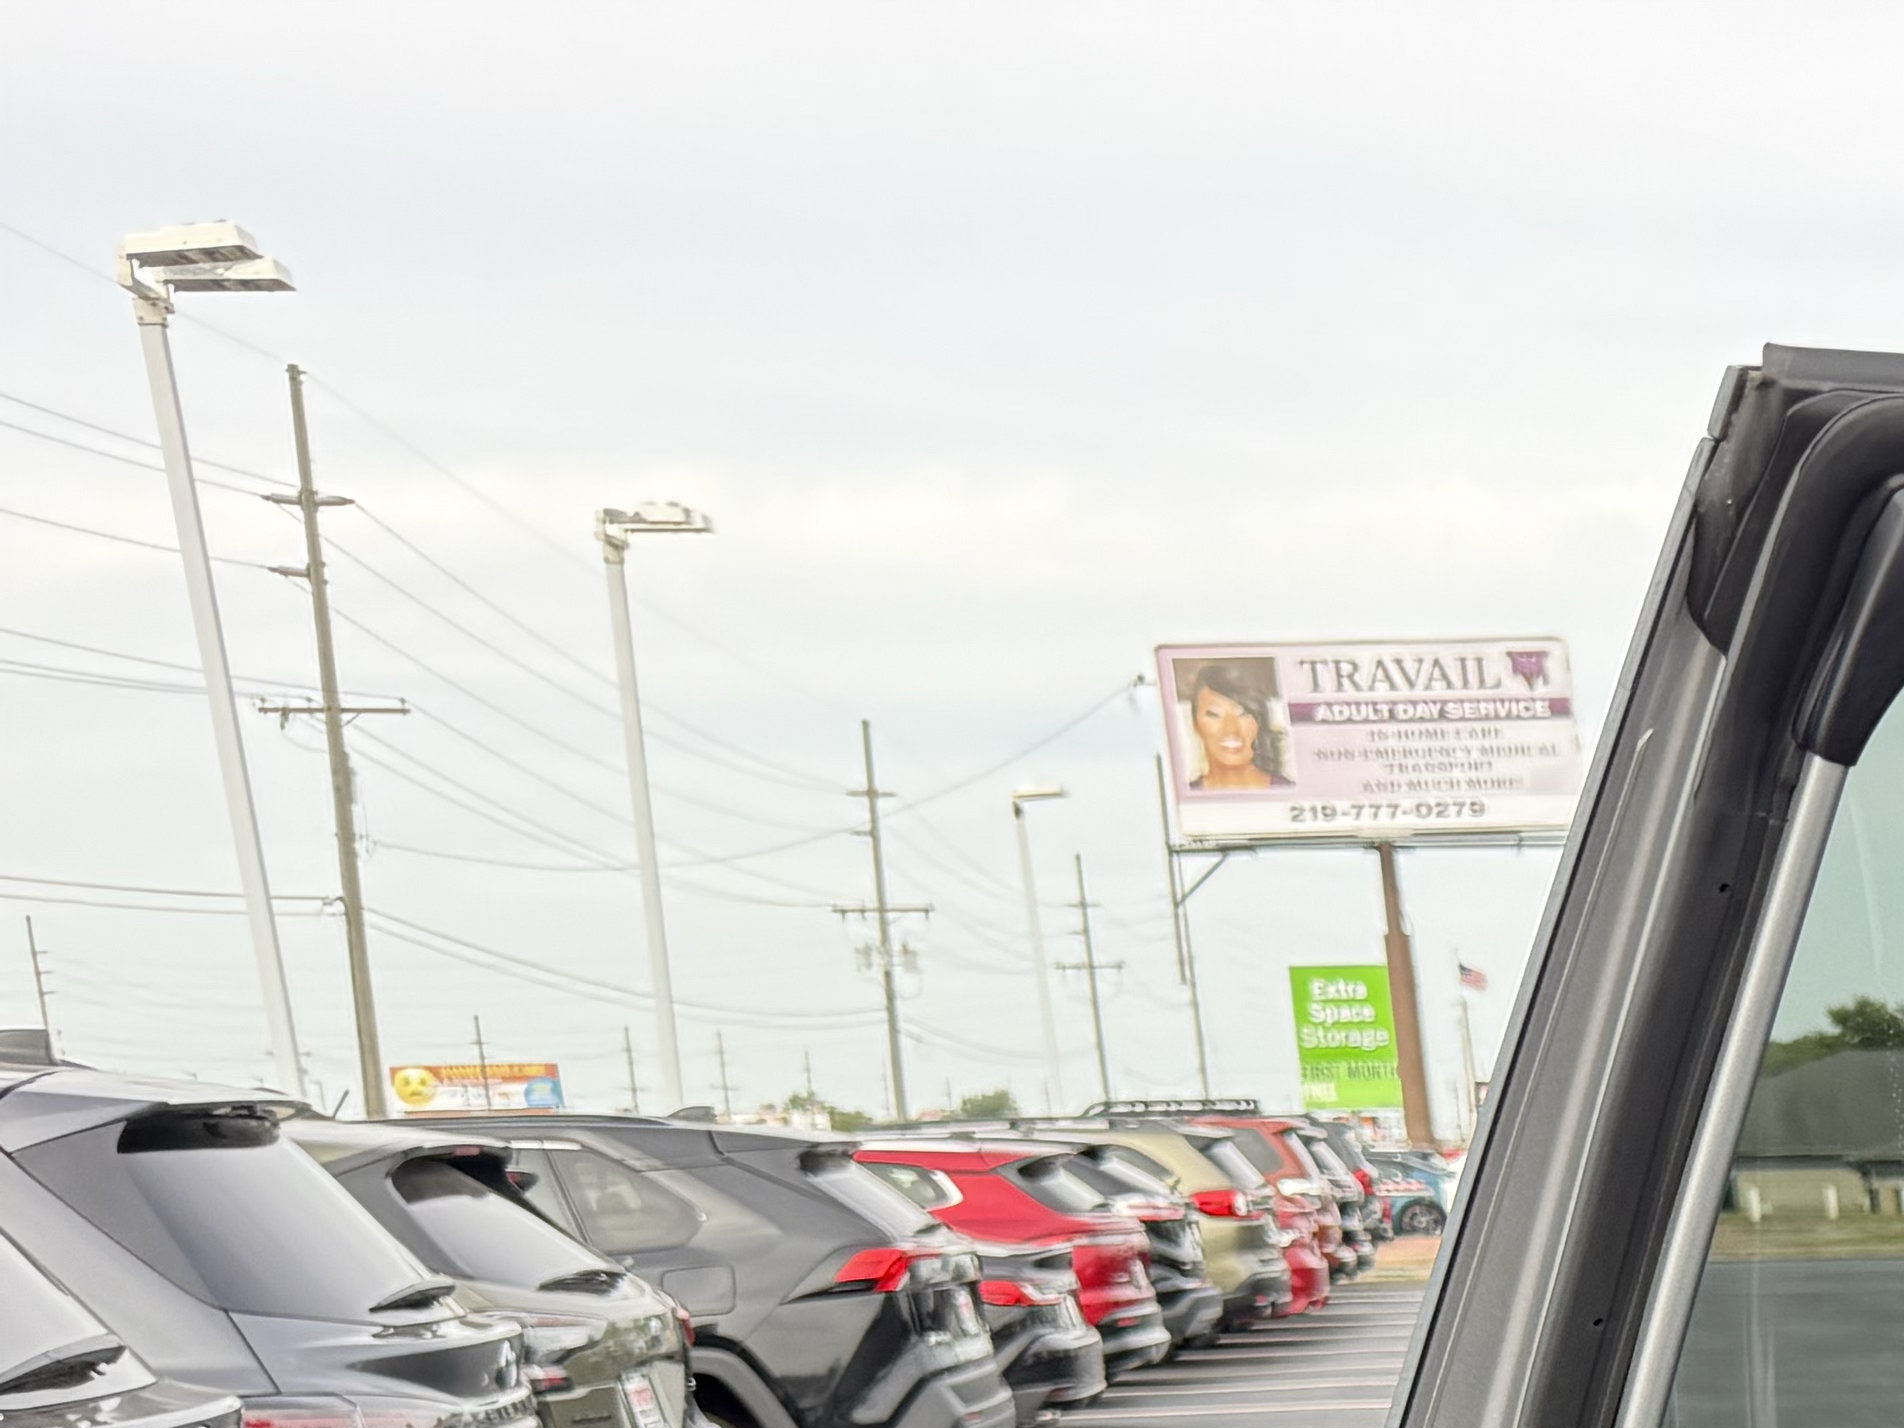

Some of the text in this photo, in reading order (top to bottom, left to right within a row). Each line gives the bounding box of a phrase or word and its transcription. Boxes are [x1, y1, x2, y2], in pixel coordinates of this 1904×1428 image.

[1300, 656, 1502, 693] TRAVAIL
[1314, 699, 1551, 722] ADULT DAY SERVICE
[1290, 800, 1486, 824] 219-777-0279
[1310, 978, 1368, 999] Extra
[1309, 1002, 1376, 1026] Space
[1301, 1024, 1390, 1051] Storage
